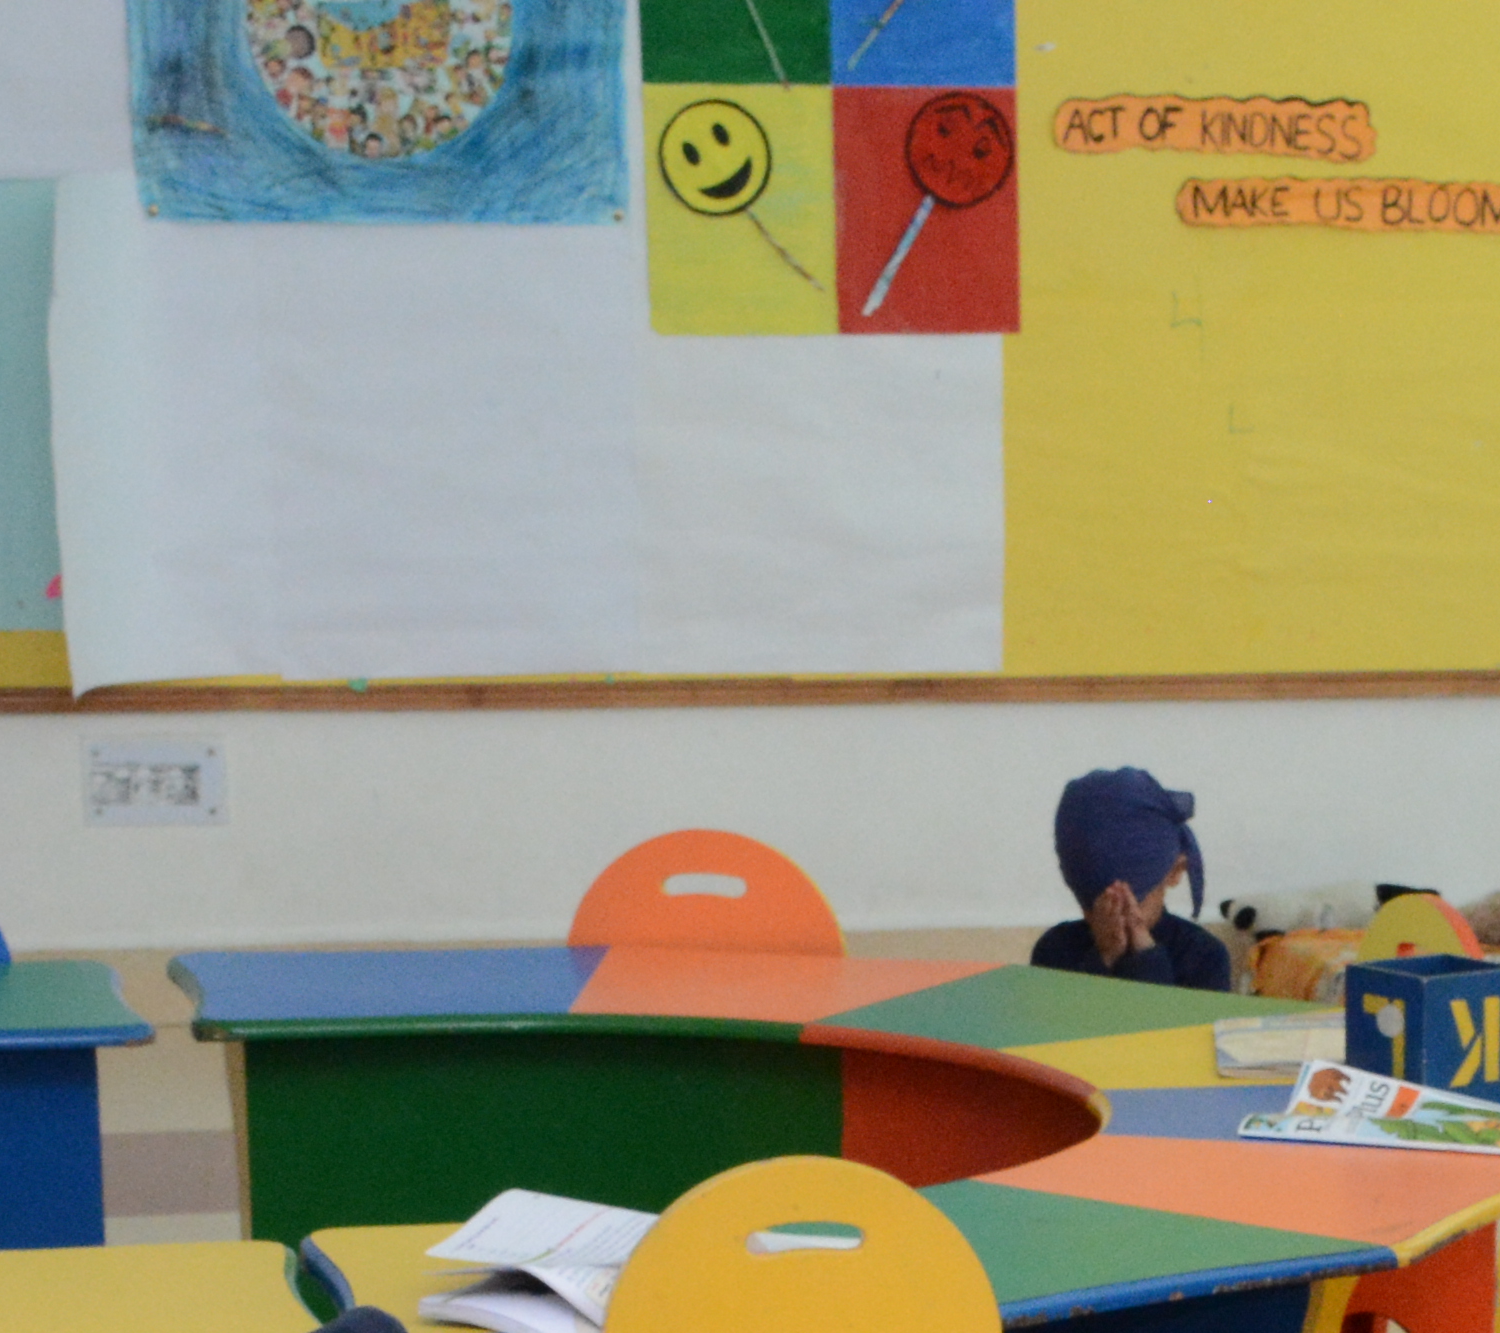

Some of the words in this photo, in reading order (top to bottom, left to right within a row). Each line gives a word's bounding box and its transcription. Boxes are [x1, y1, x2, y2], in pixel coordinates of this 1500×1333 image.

[1063, 105, 1126, 143] ACT
[1138, 106, 1183, 141] OF
[1200, 109, 1364, 160] KINDNESS
[1192, 185, 1290, 219] MAKE
[1314, 188, 1364, 223] US
